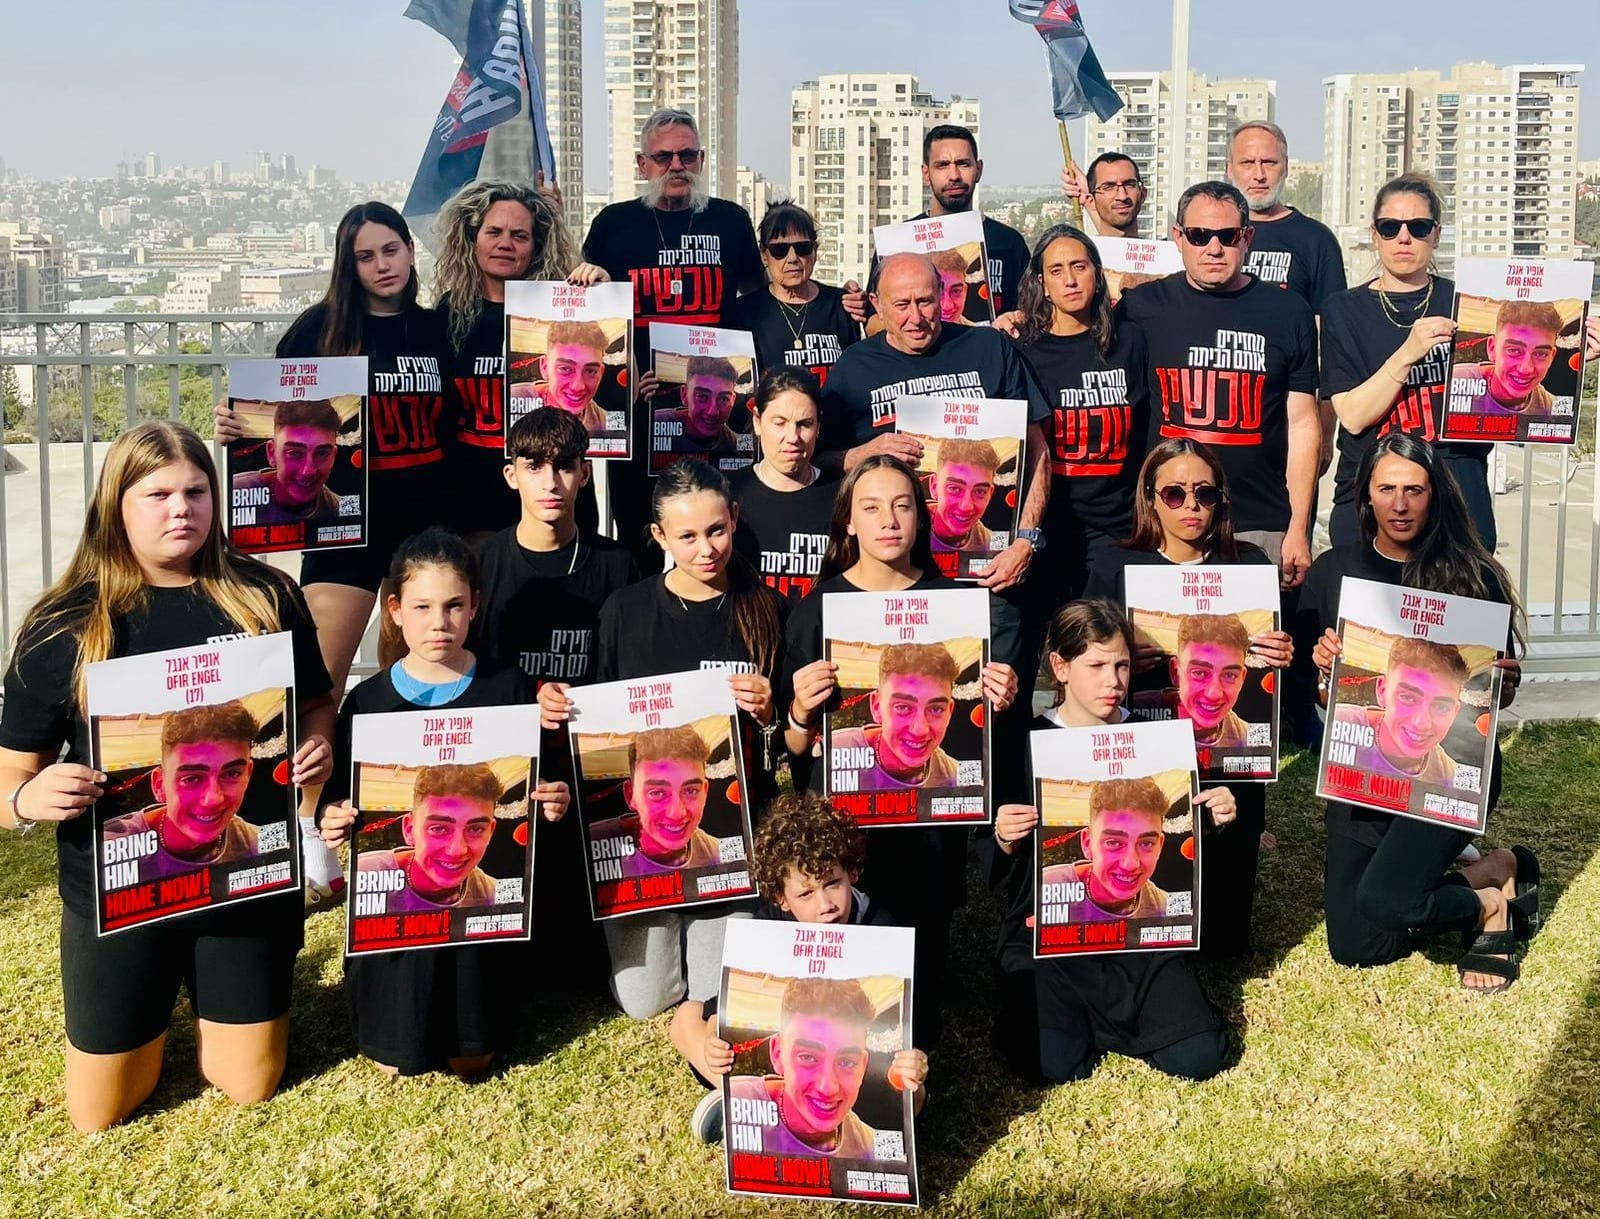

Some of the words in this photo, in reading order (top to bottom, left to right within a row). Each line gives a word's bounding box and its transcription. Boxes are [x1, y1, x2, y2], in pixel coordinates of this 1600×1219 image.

[681, 234, 720, 250] מחזירים
[658, 249, 694, 265] הביתה
[695, 249, 722, 265] אותם
[1249, 251, 1291, 267] מחזירים
[1260, 265, 1289, 282] אותם
[1506, 276, 1521, 286] OFIR
[1523, 277, 1543, 287] ENGEL
[628, 266, 724, 313] עכשיו
[1217, 329, 1266, 353] מחזירים
[396, 356, 439, 374] מחזירים
[474, 357, 505, 374] ביתה
[784, 349, 820, 366] הביתה
[1188, 346, 1231, 368] הביתה
[1233, 349, 1267, 372] אותם
[280, 376, 295, 386] OFIR
[297, 375, 318, 385] ENGEL
[374, 373, 413, 392] הביתה
[907, 374, 959, 395] המשפחות
[957, 370, 982, 388] מטה
[1081, 368, 1127, 389] מחזירים
[1450, 377, 1486, 396] BRING
[1060, 388, 1100, 407] הביתה
[1100, 386, 1129, 405] אותם
[1156, 368, 1266, 429] עכשיו
[1449, 395, 1472, 413] HIM
[369, 396, 443, 452] עכש
[944, 414, 958, 424] OFIR
[960, 415, 979, 425] ENGEL
[654, 422, 682, 436] BRING
[1054, 406, 1132, 460] עכש
[653, 437, 671, 451] HIM
[233, 487, 269, 507] BRING
[233, 507, 256, 526] HIM
[790, 533, 830, 554] חזירים
[760, 551, 804, 574] הביתה
[1182, 572, 1199, 583] אנגל
[1201, 572, 1222, 583] אופיר
[1183, 586, 1199, 596] OFIR
[1201, 586, 1223, 596] ENGEL
[885, 598, 903, 611] אנגל
[906, 598, 928, 610] אופיר
[1196, 598, 1210, 611] (17)
[1401, 594, 1421, 608] אנגל
[1423, 597, 1447, 612] אופיר
[885, 613, 902, 625] OFIR
[905, 612, 929, 625] ENGEL
[1400, 607, 1419, 621] OFIR
[1420, 611, 1446, 626] ENGEL
[900, 626, 914, 640] (17)
[1413, 622, 1429, 637] (17)
[166, 656, 189, 674] אנגל
[192, 651, 220, 669] אופיר
[520, 651, 565, 678] הביתה
[167, 673, 189, 690] OFIR
[192, 668, 221, 686] ENGEL
[186, 686, 204, 705] (17)
[627, 685, 647, 699] אנגל
[648, 682, 672, 697] אופיר
[629, 700, 647, 714] OFIR
[649, 696, 674, 711] ENGEL
[423, 718, 445, 731] אנגל
[447, 717, 473, 730] אופיר
[645, 711, 661, 727] (17)
[423, 733, 443, 746] OFIR
[446, 732, 473, 745] ENGEL
[1091, 733, 1110, 747] אנגל
[1112, 731, 1135, 745] אופיר
[1331, 720, 1374, 748] BRING
[439, 746, 455, 761] (17)
[832, 747, 874, 769] BRING
[1093, 748, 1110, 761] OFIR
[1112, 746, 1136, 760] ENGEL
[1328, 741, 1357, 766] HIM
[1108, 761, 1123, 776] (17)
[832, 770, 858, 792] HIM
[1326, 765, 1364, 791] HOME
[1368, 774, 1412, 802] NOW!
[931, 804, 960, 815] FAMILIES
[961, 803, 983, 814] FORUM
[104, 829, 158, 865] BRING
[592, 835, 634, 860] BRING
[105, 860, 139, 891] HIM
[594, 859, 622, 881] HIM
[229, 873, 263, 893] FAMILIES
[264, 867, 291, 885] FORUM
[356, 869, 405, 893] BRING
[697, 880, 727, 894] FAMILIES
[727, 877, 750, 890] FORUM
[106, 884, 156, 919] HOME
[160, 867, 210, 905] NOW!
[1042, 882, 1085, 903] BRING
[356, 893, 386, 916] HIM
[1042, 904, 1068, 924] HIM
[355, 917, 399, 940] HOME
[403, 910, 449, 936] NOW!
[466, 921, 497, 934] FAMILIES
[498, 919, 523, 931] FORUM
[1042, 926, 1080, 946] HOME
[1084, 920, 1125, 943] NOW!
[794, 929, 816, 942] אנגל
[818, 930, 845, 944] אופיר
[1140, 932, 1169, 943] FAMILIES
[1169, 931, 1192, 941] FORUM
[793, 944, 814, 957] OFIR
[816, 945, 844, 959] ENGEL
[808, 959, 826, 974] (17)
[731, 1097, 778, 1126] BRING
[732, 1124, 762, 1152] HIM
[733, 1153, 779, 1182] HOME
[781, 1156, 830, 1186] NOW!
